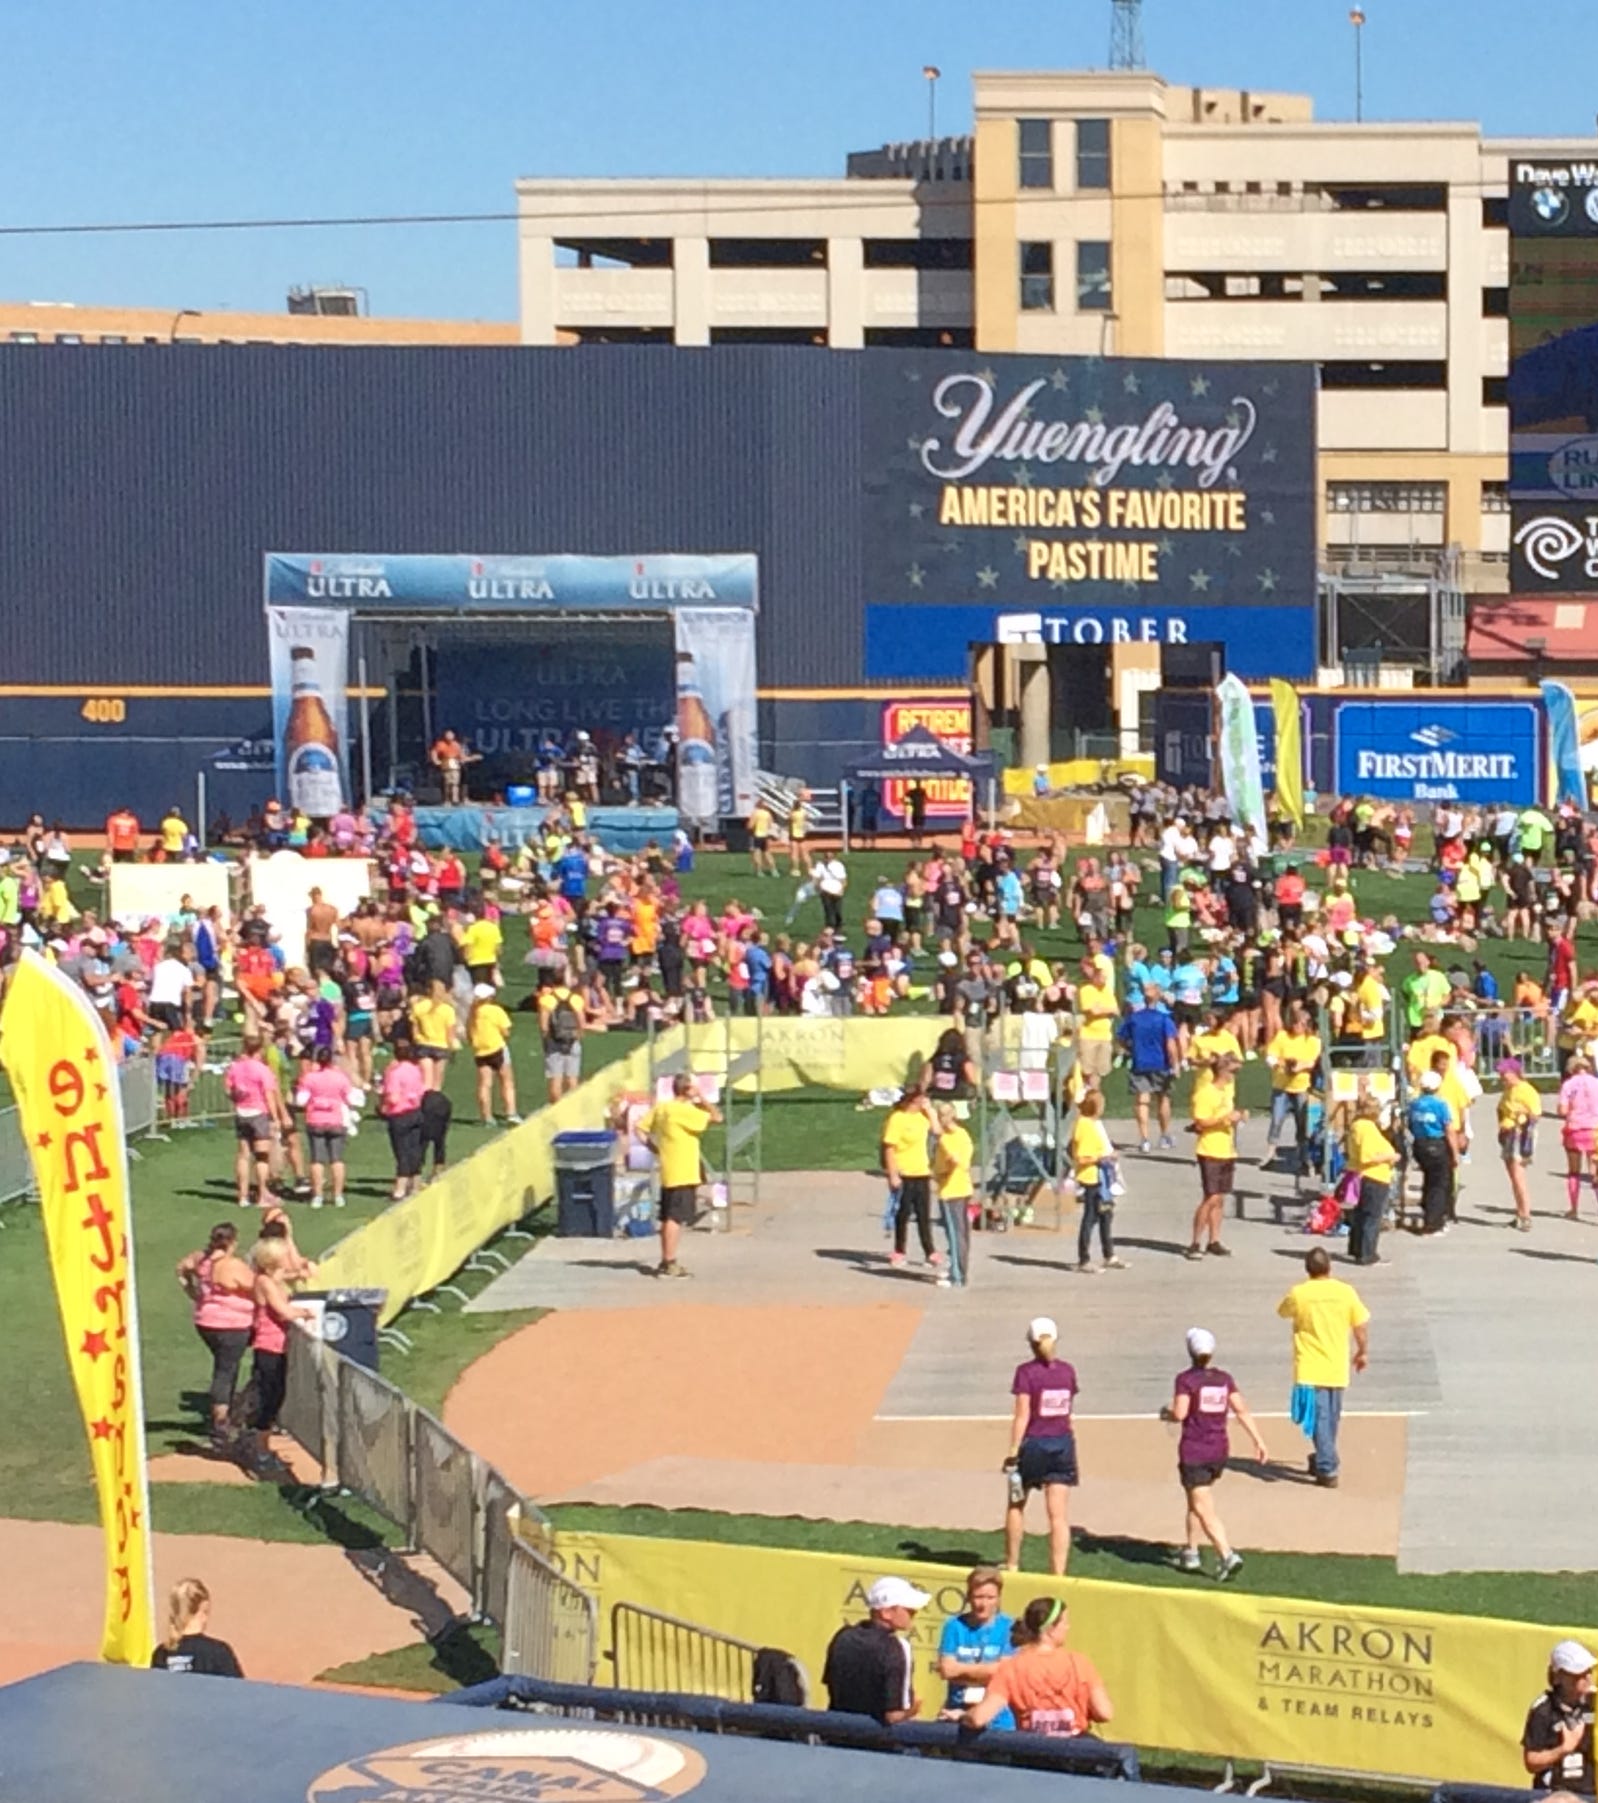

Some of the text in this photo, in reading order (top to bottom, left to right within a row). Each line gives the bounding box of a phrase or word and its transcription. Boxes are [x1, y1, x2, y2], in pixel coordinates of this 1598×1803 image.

[920, 373, 1256, 488] Yuengling
[940, 486, 1247, 531] AMERICA'S FAVORITE
[1029, 541, 1159, 582] PASTIME
[306, 576, 393, 599] ULTRA
[468, 577, 555, 600] ULTRA
[629, 577, 717, 600] ULTRA
[275, 623, 345, 639] ULTRA
[81, 698, 127, 723] 400
[475, 697, 674, 721] LONG LIVE TH
[475, 727, 583, 753] ULTR
[1413, 782, 1458, 800] Bank
[1259, 1619, 1433, 1665] AKRON
[1258, 1659, 1434, 1698] MARATHON
[1257, 1695, 1434, 1728] & TEAM RELAYS
[419, 1761, 610, 1793] CANAL
